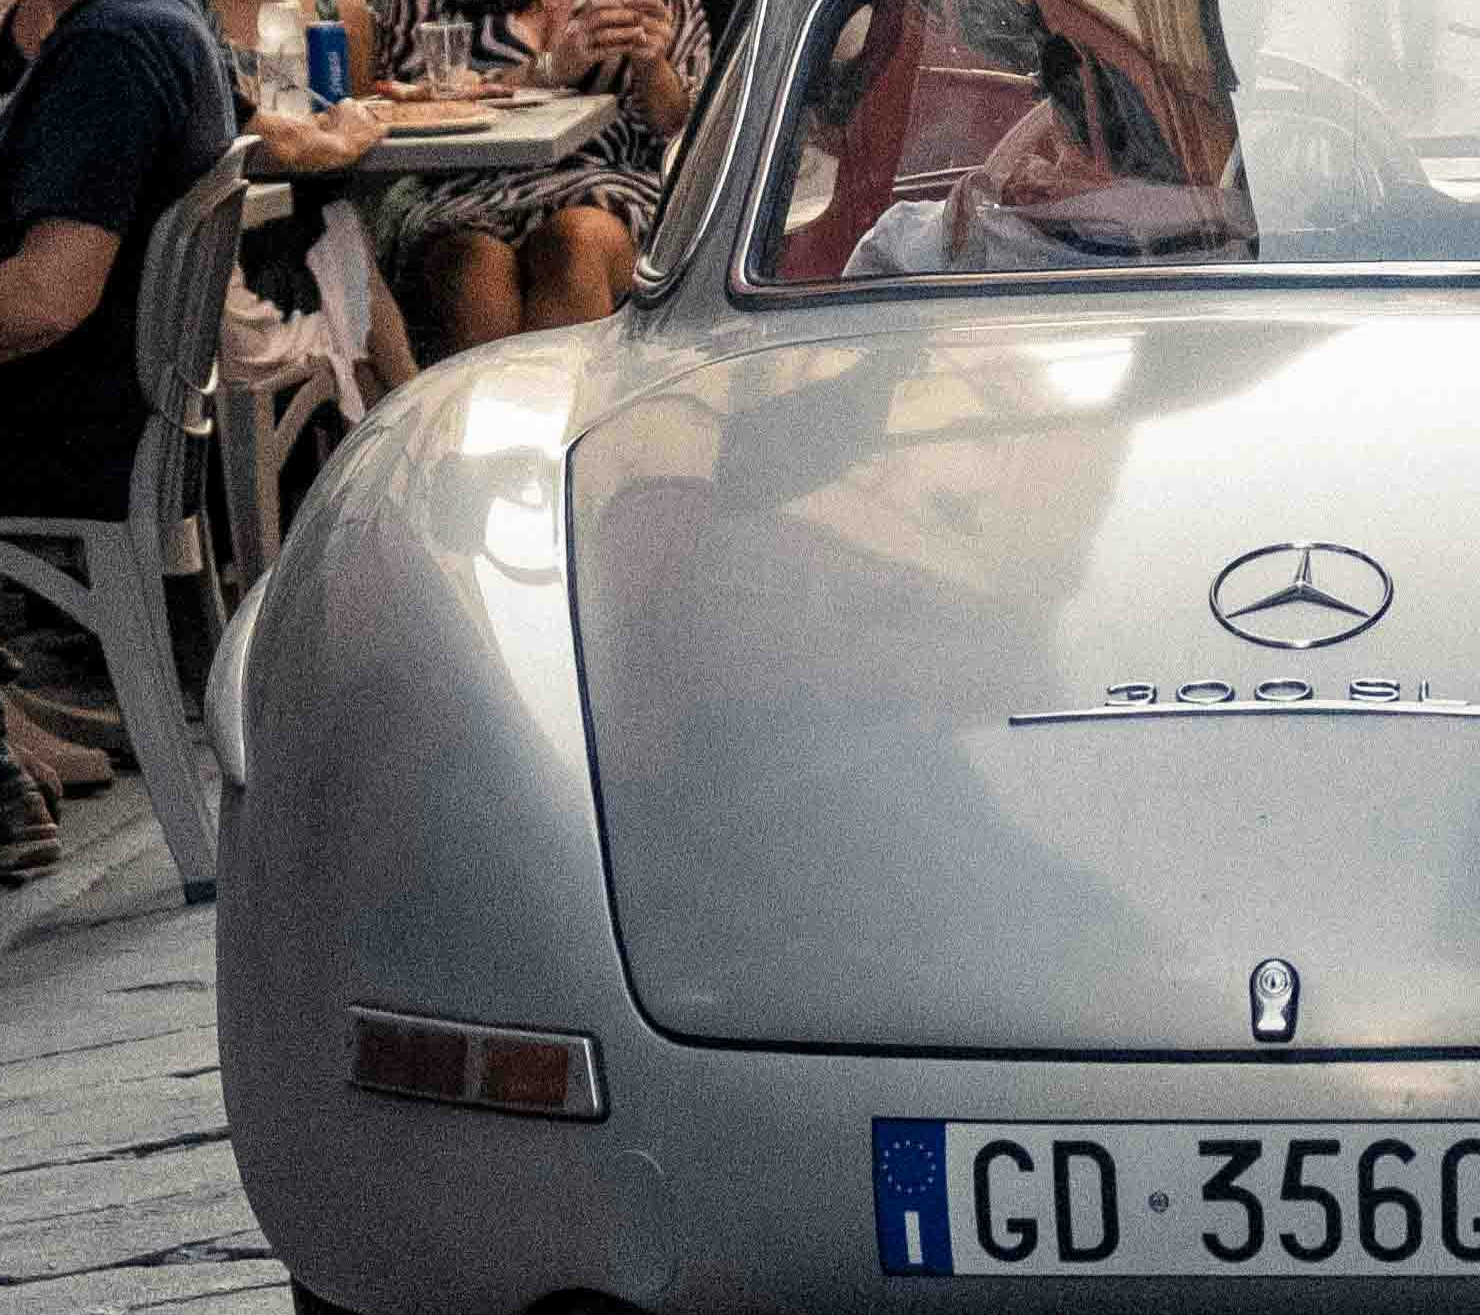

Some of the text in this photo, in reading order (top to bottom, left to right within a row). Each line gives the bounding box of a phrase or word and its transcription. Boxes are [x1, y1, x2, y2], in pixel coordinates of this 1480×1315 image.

[1105, 678, 1471, 706] 300 SL
[973, 1139, 1120, 1264] GD
